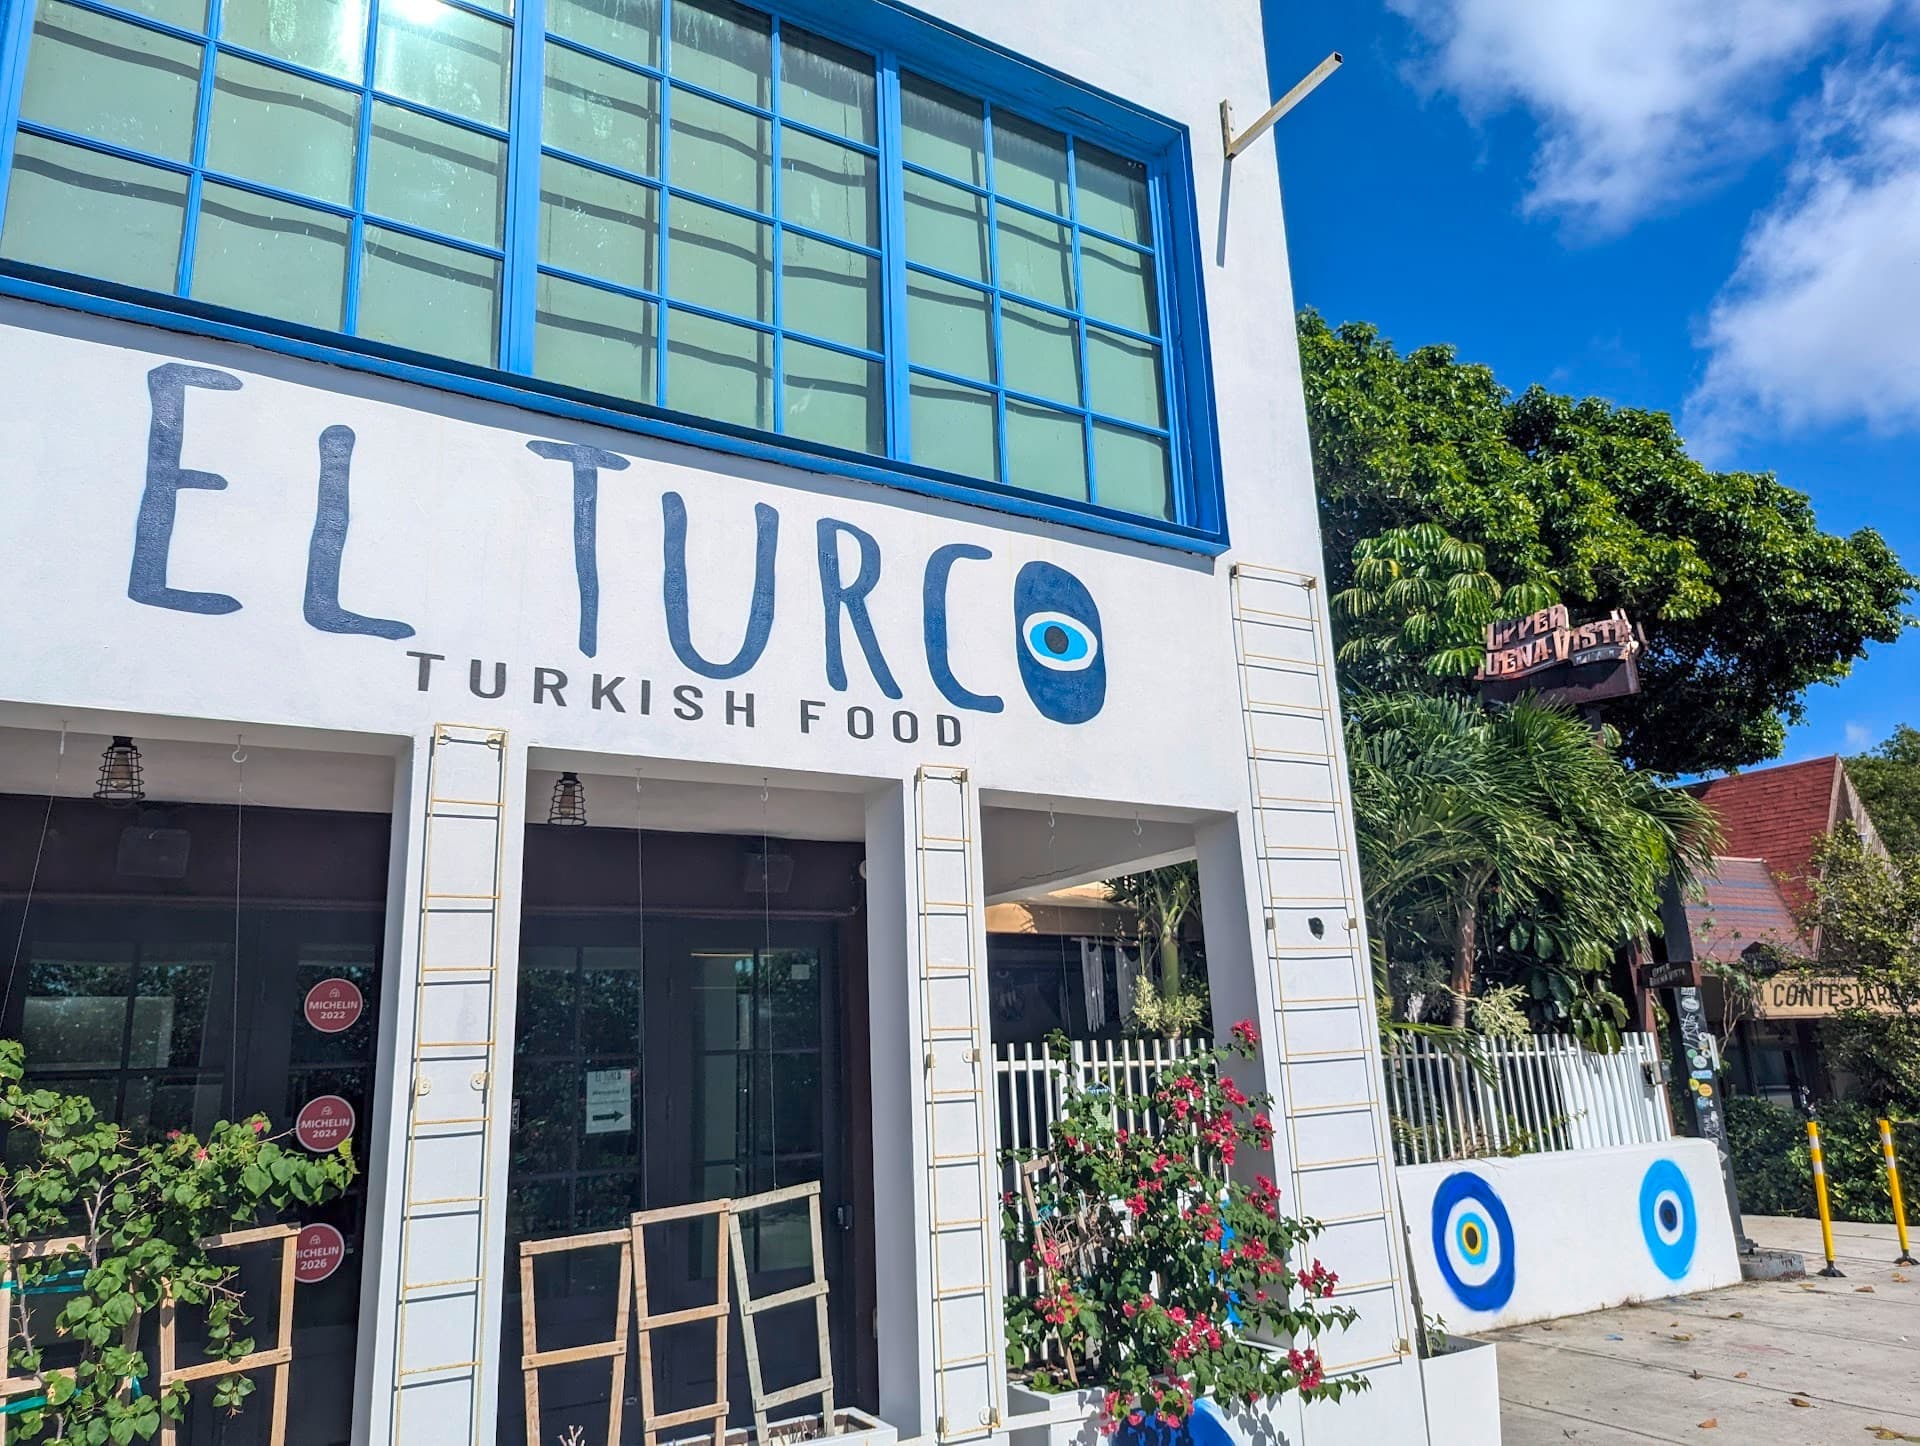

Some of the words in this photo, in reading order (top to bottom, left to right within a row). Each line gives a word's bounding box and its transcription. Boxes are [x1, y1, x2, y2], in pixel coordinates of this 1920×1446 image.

[128, 363, 415, 639] EL
[527, 439, 1107, 725] TURCO
[1486, 604, 1569, 650] UPPER
[1473, 639, 1550, 680] UENA
[1552, 619, 1631, 661] VISTA
[406, 651, 756, 729] TURKISH
[800, 701, 963, 747] FOOD
[308, 999, 359, 1010] MICHELIN
[320, 1010, 346, 1020] 2022
[301, 1118, 350, 1129] MICHELIN
[312, 1129, 338, 1138] 2024
[300, 1259, 327, 1270] 2026
